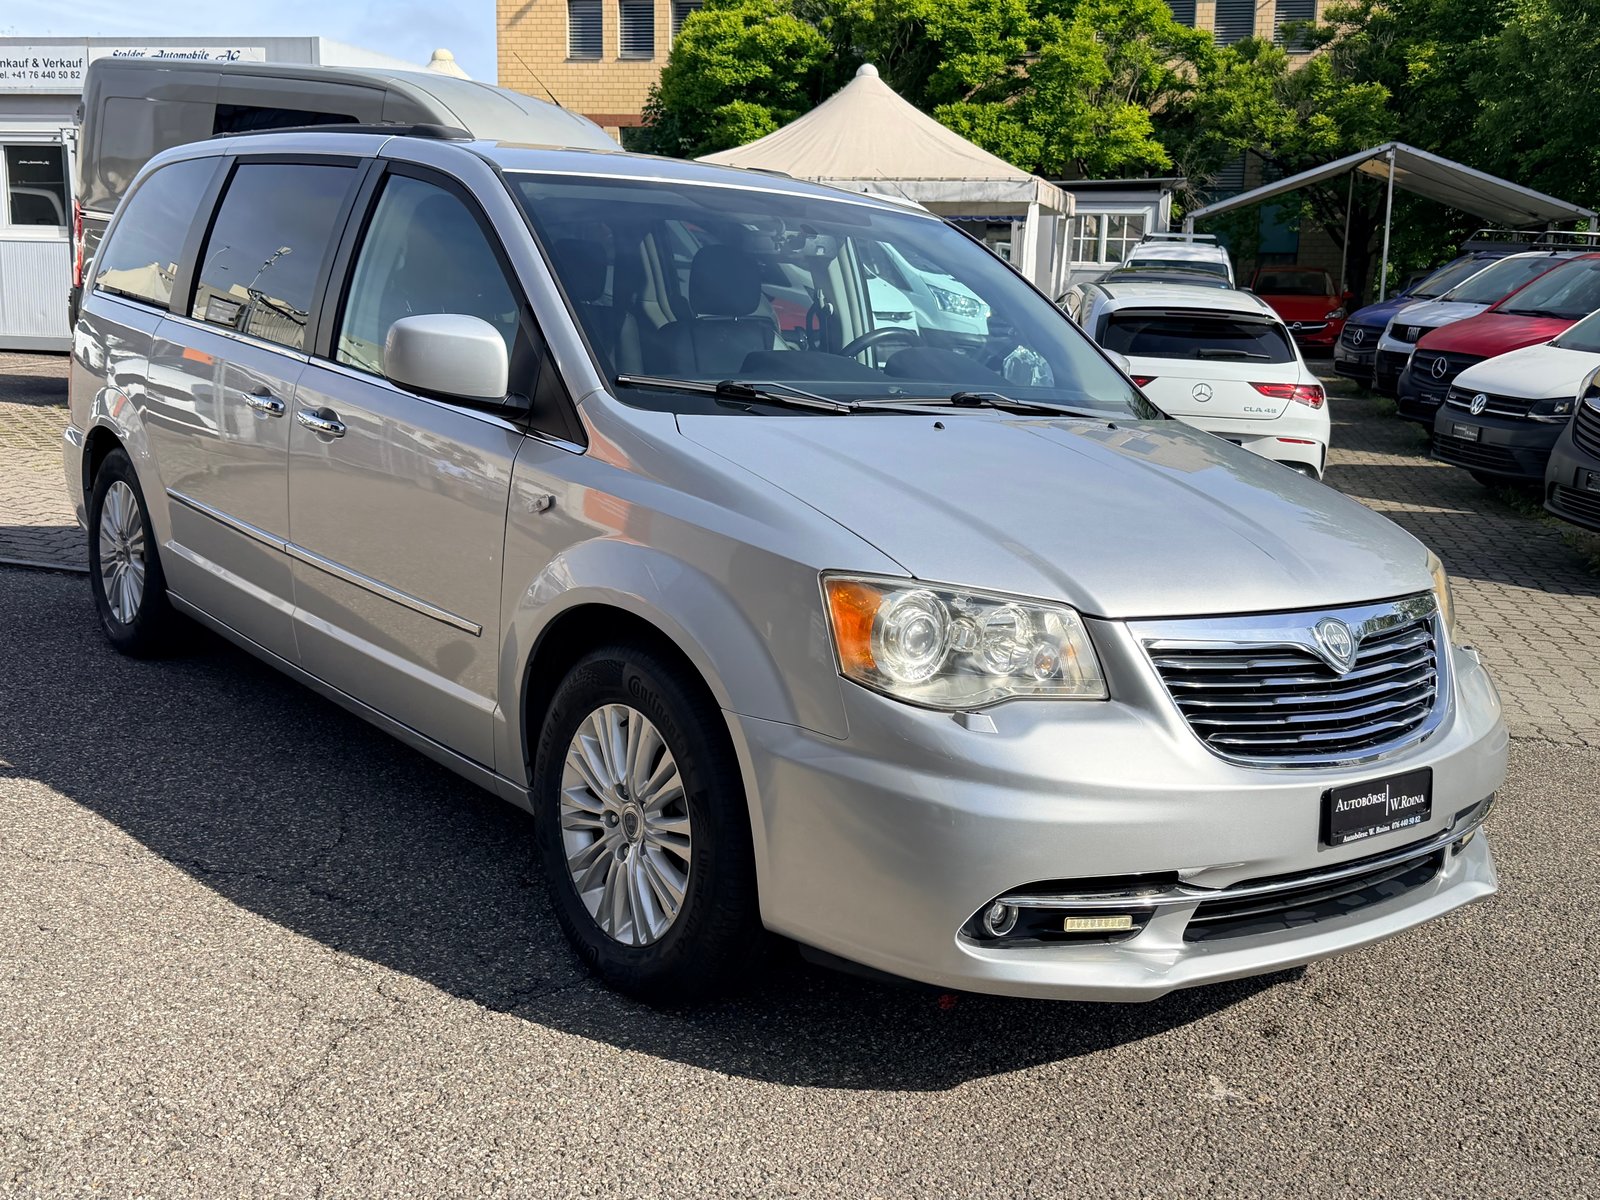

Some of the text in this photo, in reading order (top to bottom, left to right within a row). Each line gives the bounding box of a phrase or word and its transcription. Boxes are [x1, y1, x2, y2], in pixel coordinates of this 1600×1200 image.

[216, 50, 240, 61] AG
[32, 58, 39, 68] &
[42, 58, 82, 68] Verkauf
[12, 71, 26, 79] +41
[29, 71, 39, 79] 76
[41, 71, 56, 79] 440
[58, 71, 68, 79] 50
[70, 71, 81, 79] 82
